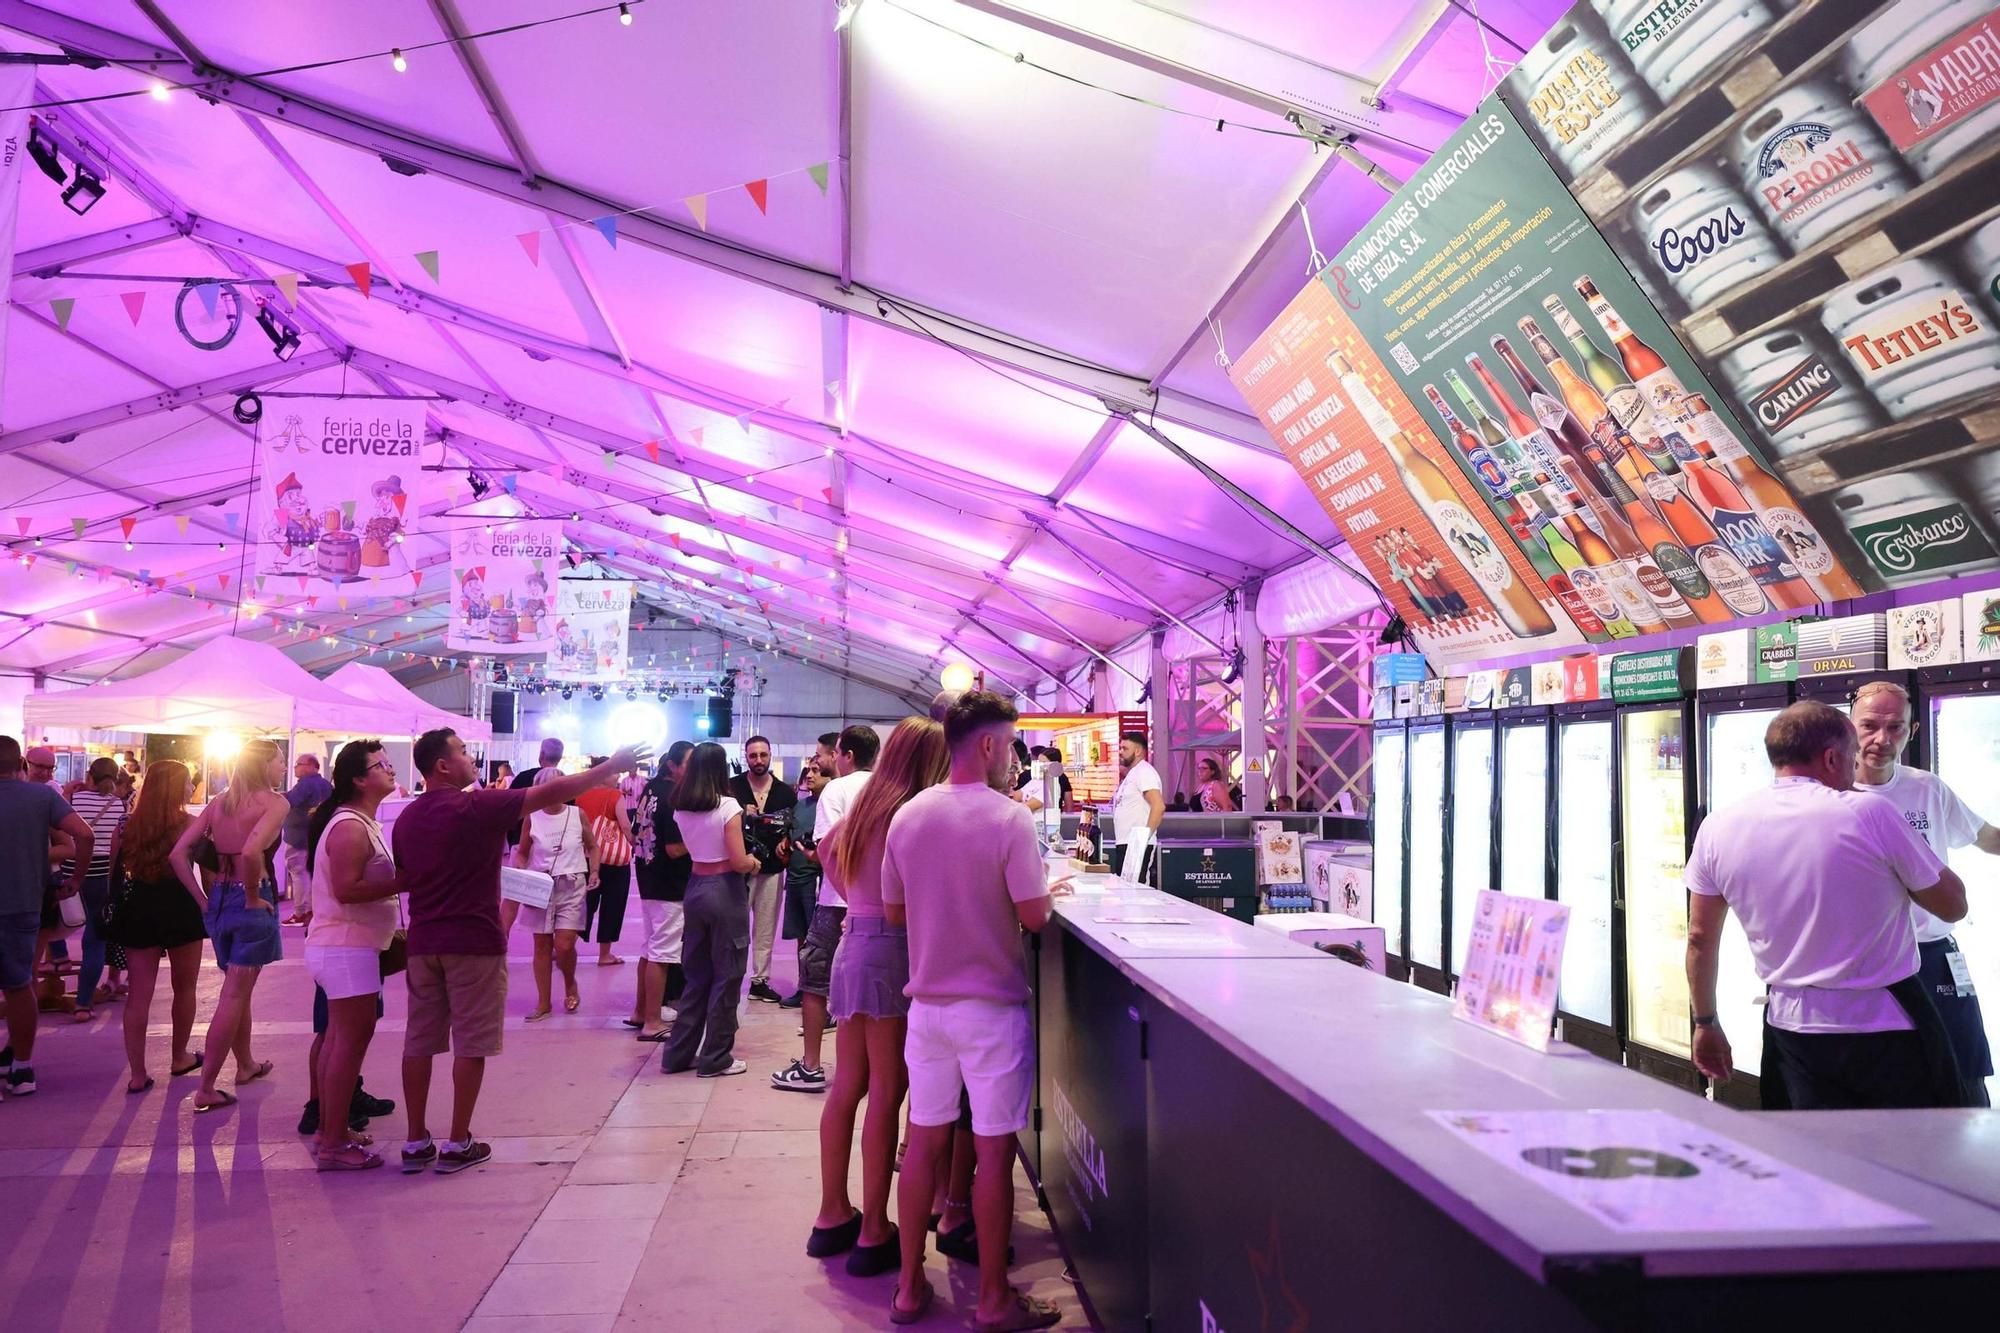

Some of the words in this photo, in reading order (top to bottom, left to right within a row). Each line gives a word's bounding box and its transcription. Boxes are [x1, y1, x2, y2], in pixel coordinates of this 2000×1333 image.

[1653, 28, 1668, 42] DE
[1527, 48, 1608, 126] PUNTA
[1552, 76, 1621, 144] ESTE
[1762, 140, 1864, 212] PERONI
[1345, 200, 1418, 277] PROMOCIONES
[1412, 113, 1506, 209] COMERCIALES
[1783, 194, 1823, 223] NASTRO
[1822, 165, 1874, 199] AZZURRO
[1443, 247, 1452, 255] en
[1450, 234, 1465, 249] Ibiza
[1468, 199, 1507, 233] Formentera
[1652, 207, 1746, 273] Coors
[1358, 272, 1376, 294] DE
[1372, 246, 1406, 283] IBIZA,
[1399, 227, 1426, 257] S.A.
[1396, 295, 1417, 314] Cerveza
[1416, 291, 1425, 299] en
[1472, 218, 1510, 250] artesanales
[1446, 275, 1468, 293] zumos
[1470, 246, 1504, 275] productos
[1500, 237, 1511, 248] de
[1508, 206, 1554, 243] importación
[1845, 300, 1979, 371] TETLEY'S
[1242, 355, 1277, 386] VICTORIA
[1267, 393, 1299, 424] BRINDA
[1758, 363, 1831, 427] CARLING
[324, 417, 362, 436] feria
[369, 418, 390, 437] de
[397, 419, 412, 438] la
[1283, 422, 1304, 446] CON
[1300, 416, 1313, 437] LA
[1308, 393, 1345, 428] CERVEZA
[322, 437, 412, 456] cerveza
[1299, 438, 1329, 468] OFICIAL
[1325, 431, 1341, 453] DE
[1529, 436, 1546, 456] IPA
[1314, 473, 1329, 491] LA
[1325, 448, 1368, 485] SELECCIÓN
[1545, 458, 1572, 491] PUNK
[1330, 480, 1376, 512] ESPAÑOLA
[1369, 471, 1386, 492] DE
[491, 544, 551, 558] cerveza
[493, 531, 520, 545] feria
[524, 532, 539, 545] de
[542, 532, 552, 545] la
[1733, 542, 1775, 568] BAR
[1865, 513, 1970, 571] Trabanco
[578, 599, 625, 610] cerveza
[1904, 609, 1938, 629] VICTORIA
[1762, 648, 1794, 661] CRABBIE'S
[1813, 657, 1855, 673] ORVAL
[1905, 643, 1939, 664] MARENGO
[1905, 811, 1917, 820] de
[1918, 810, 1927, 820] la
[1184, 872, 1232, 880] ESTRELLA
